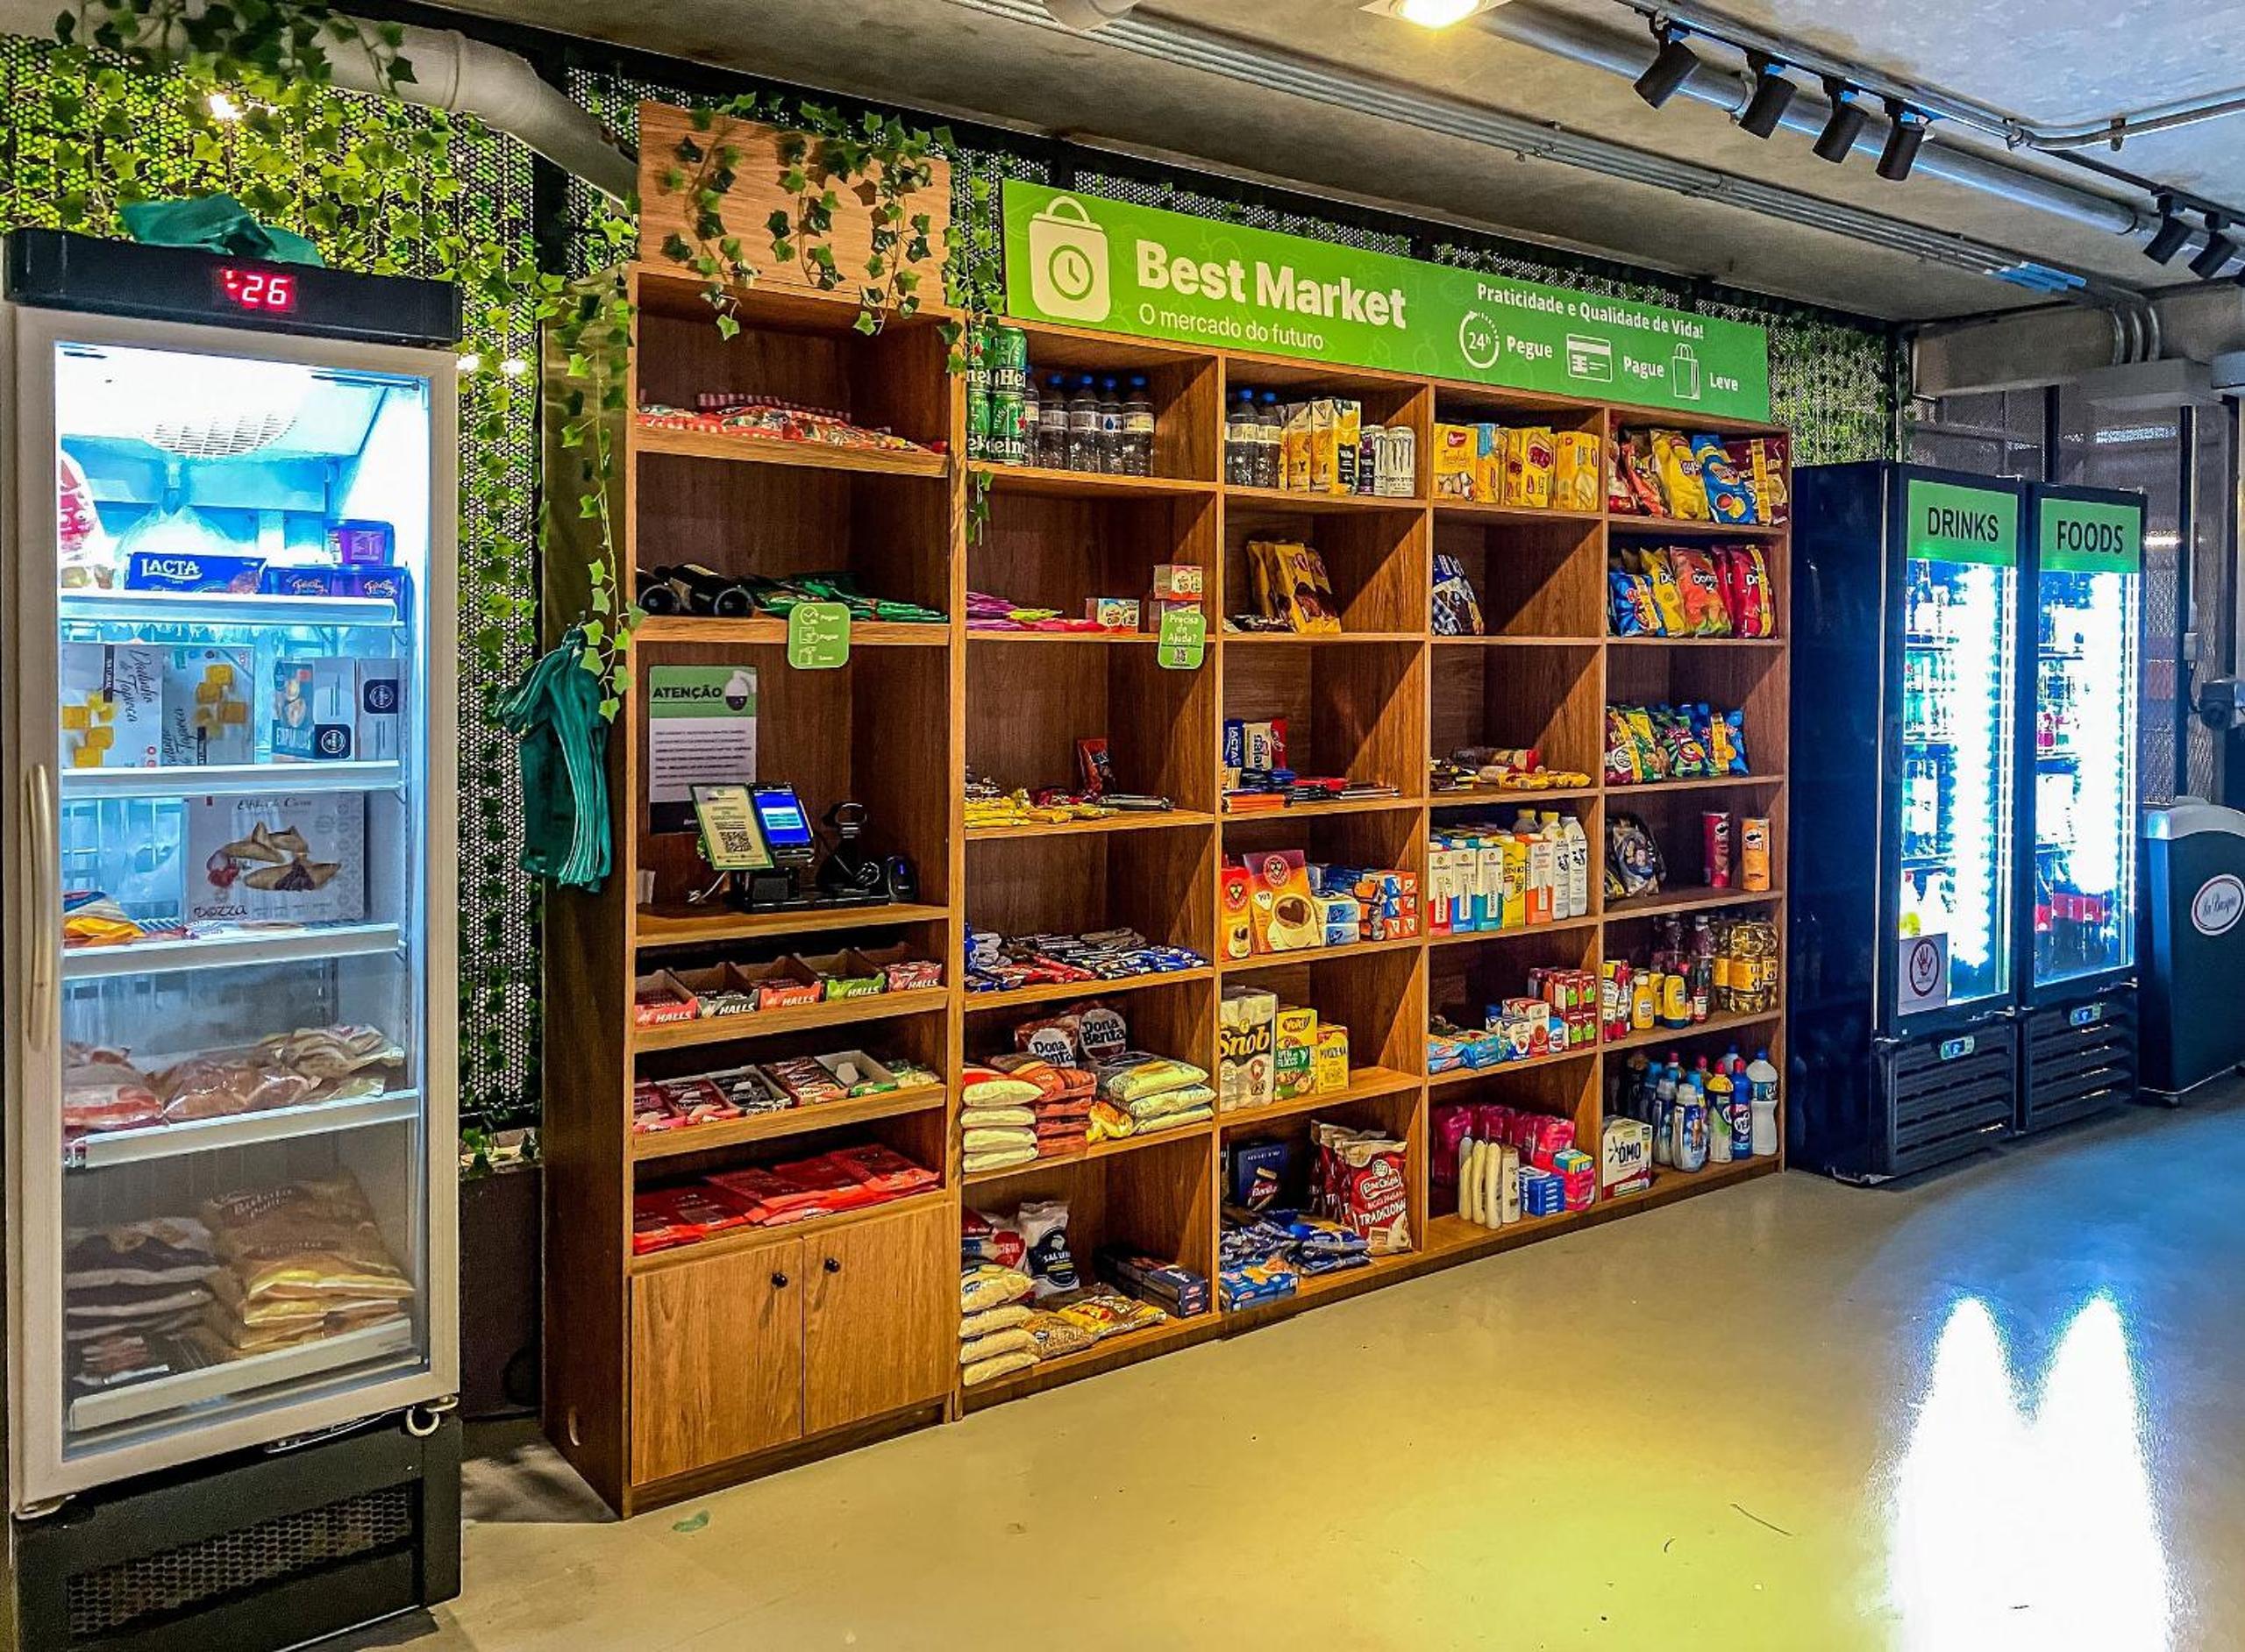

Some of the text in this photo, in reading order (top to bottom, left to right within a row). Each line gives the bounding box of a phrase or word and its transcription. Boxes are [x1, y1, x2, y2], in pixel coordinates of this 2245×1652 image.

[1136, 239, 1407, 330] Best Market
[1477, 281, 1705, 340] Praticidade e Qualidade de Vida!
[1138, 303, 1324, 351] O mercado do futuro
[1507, 334, 1553, 361] Pegue
[1623, 355, 1664, 380] Pague
[1709, 373, 1739, 392] Leve
[1928, 507, 1999, 542] DRINKS
[2056, 520, 2123, 554] FOODS
[140, 558, 200, 579] LACTA
[653, 685, 723, 700] ATENÇÃO
[848, 986, 880, 997] HALLS
[909, 979, 938, 988] HALLS
[719, 1002, 755, 1015] HALLS
[782, 996, 815, 1006] HALLS
[657, 1012, 692, 1022] HALLS
[1083, 1018, 1120, 1033] Dona
[1033, 1041, 1067, 1053] Dona
[1082, 1028, 1125, 1046] Benta
[1220, 1025, 1271, 1057] Snob
[1619, 1142, 1642, 1164] OMO
